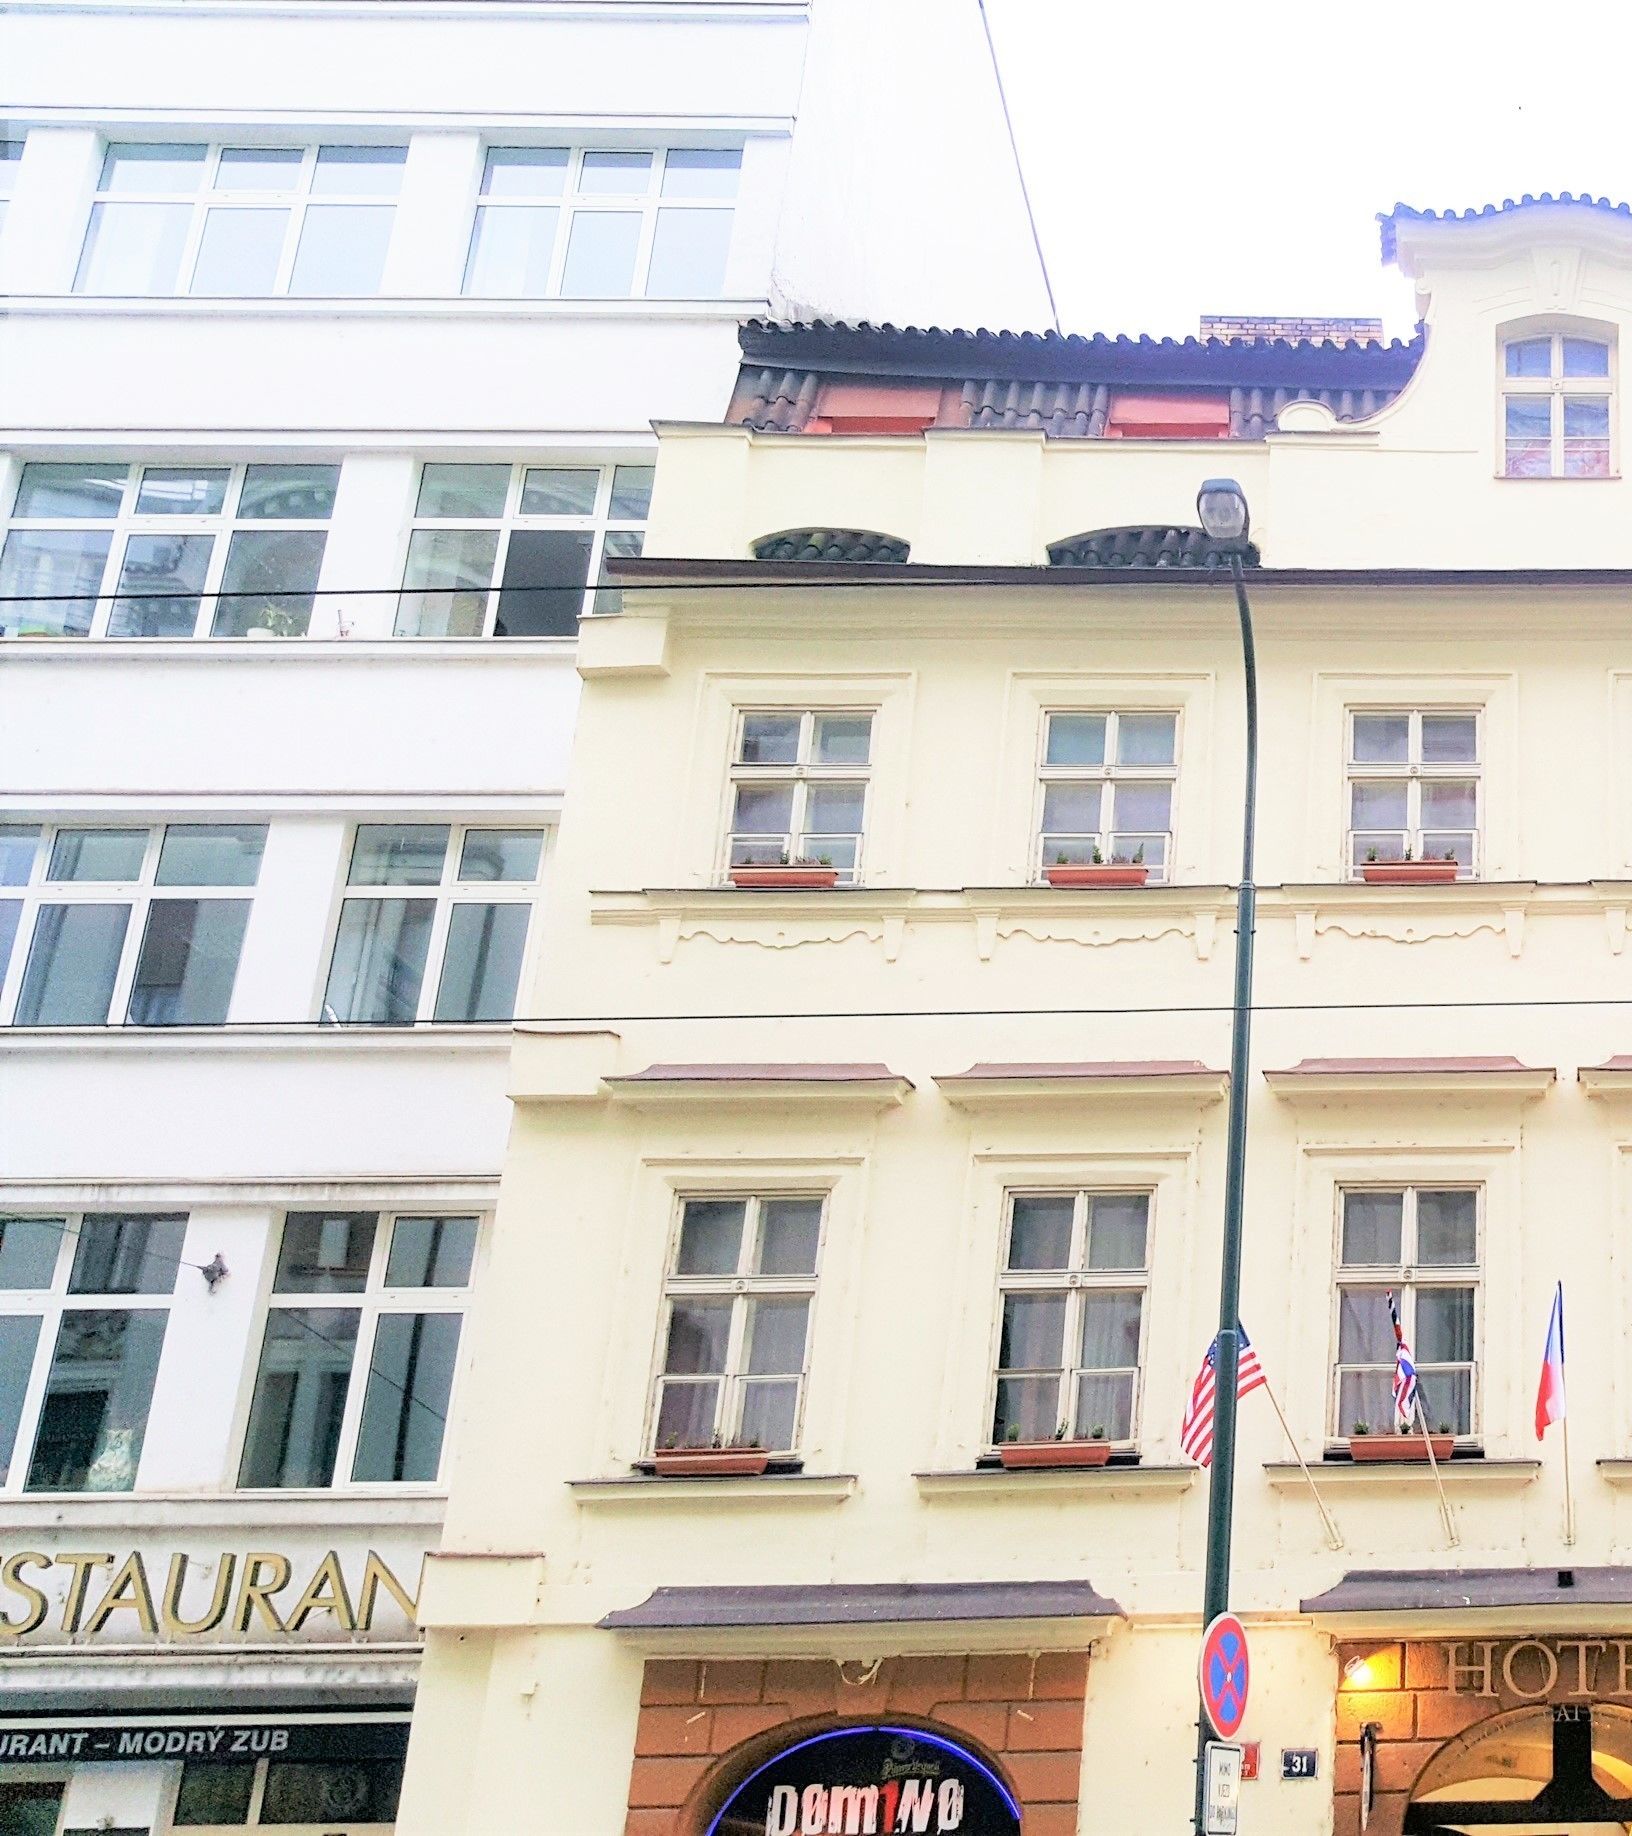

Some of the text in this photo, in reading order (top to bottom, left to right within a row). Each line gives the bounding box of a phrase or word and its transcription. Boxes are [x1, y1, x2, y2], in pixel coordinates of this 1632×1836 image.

[0, 1550, 431, 1635] STAURAN
[118, 1725, 225, 1754] MODRÝ
[229, 1729, 290, 1752] ZUB
[1290, 1753, 1309, 1773] 31
